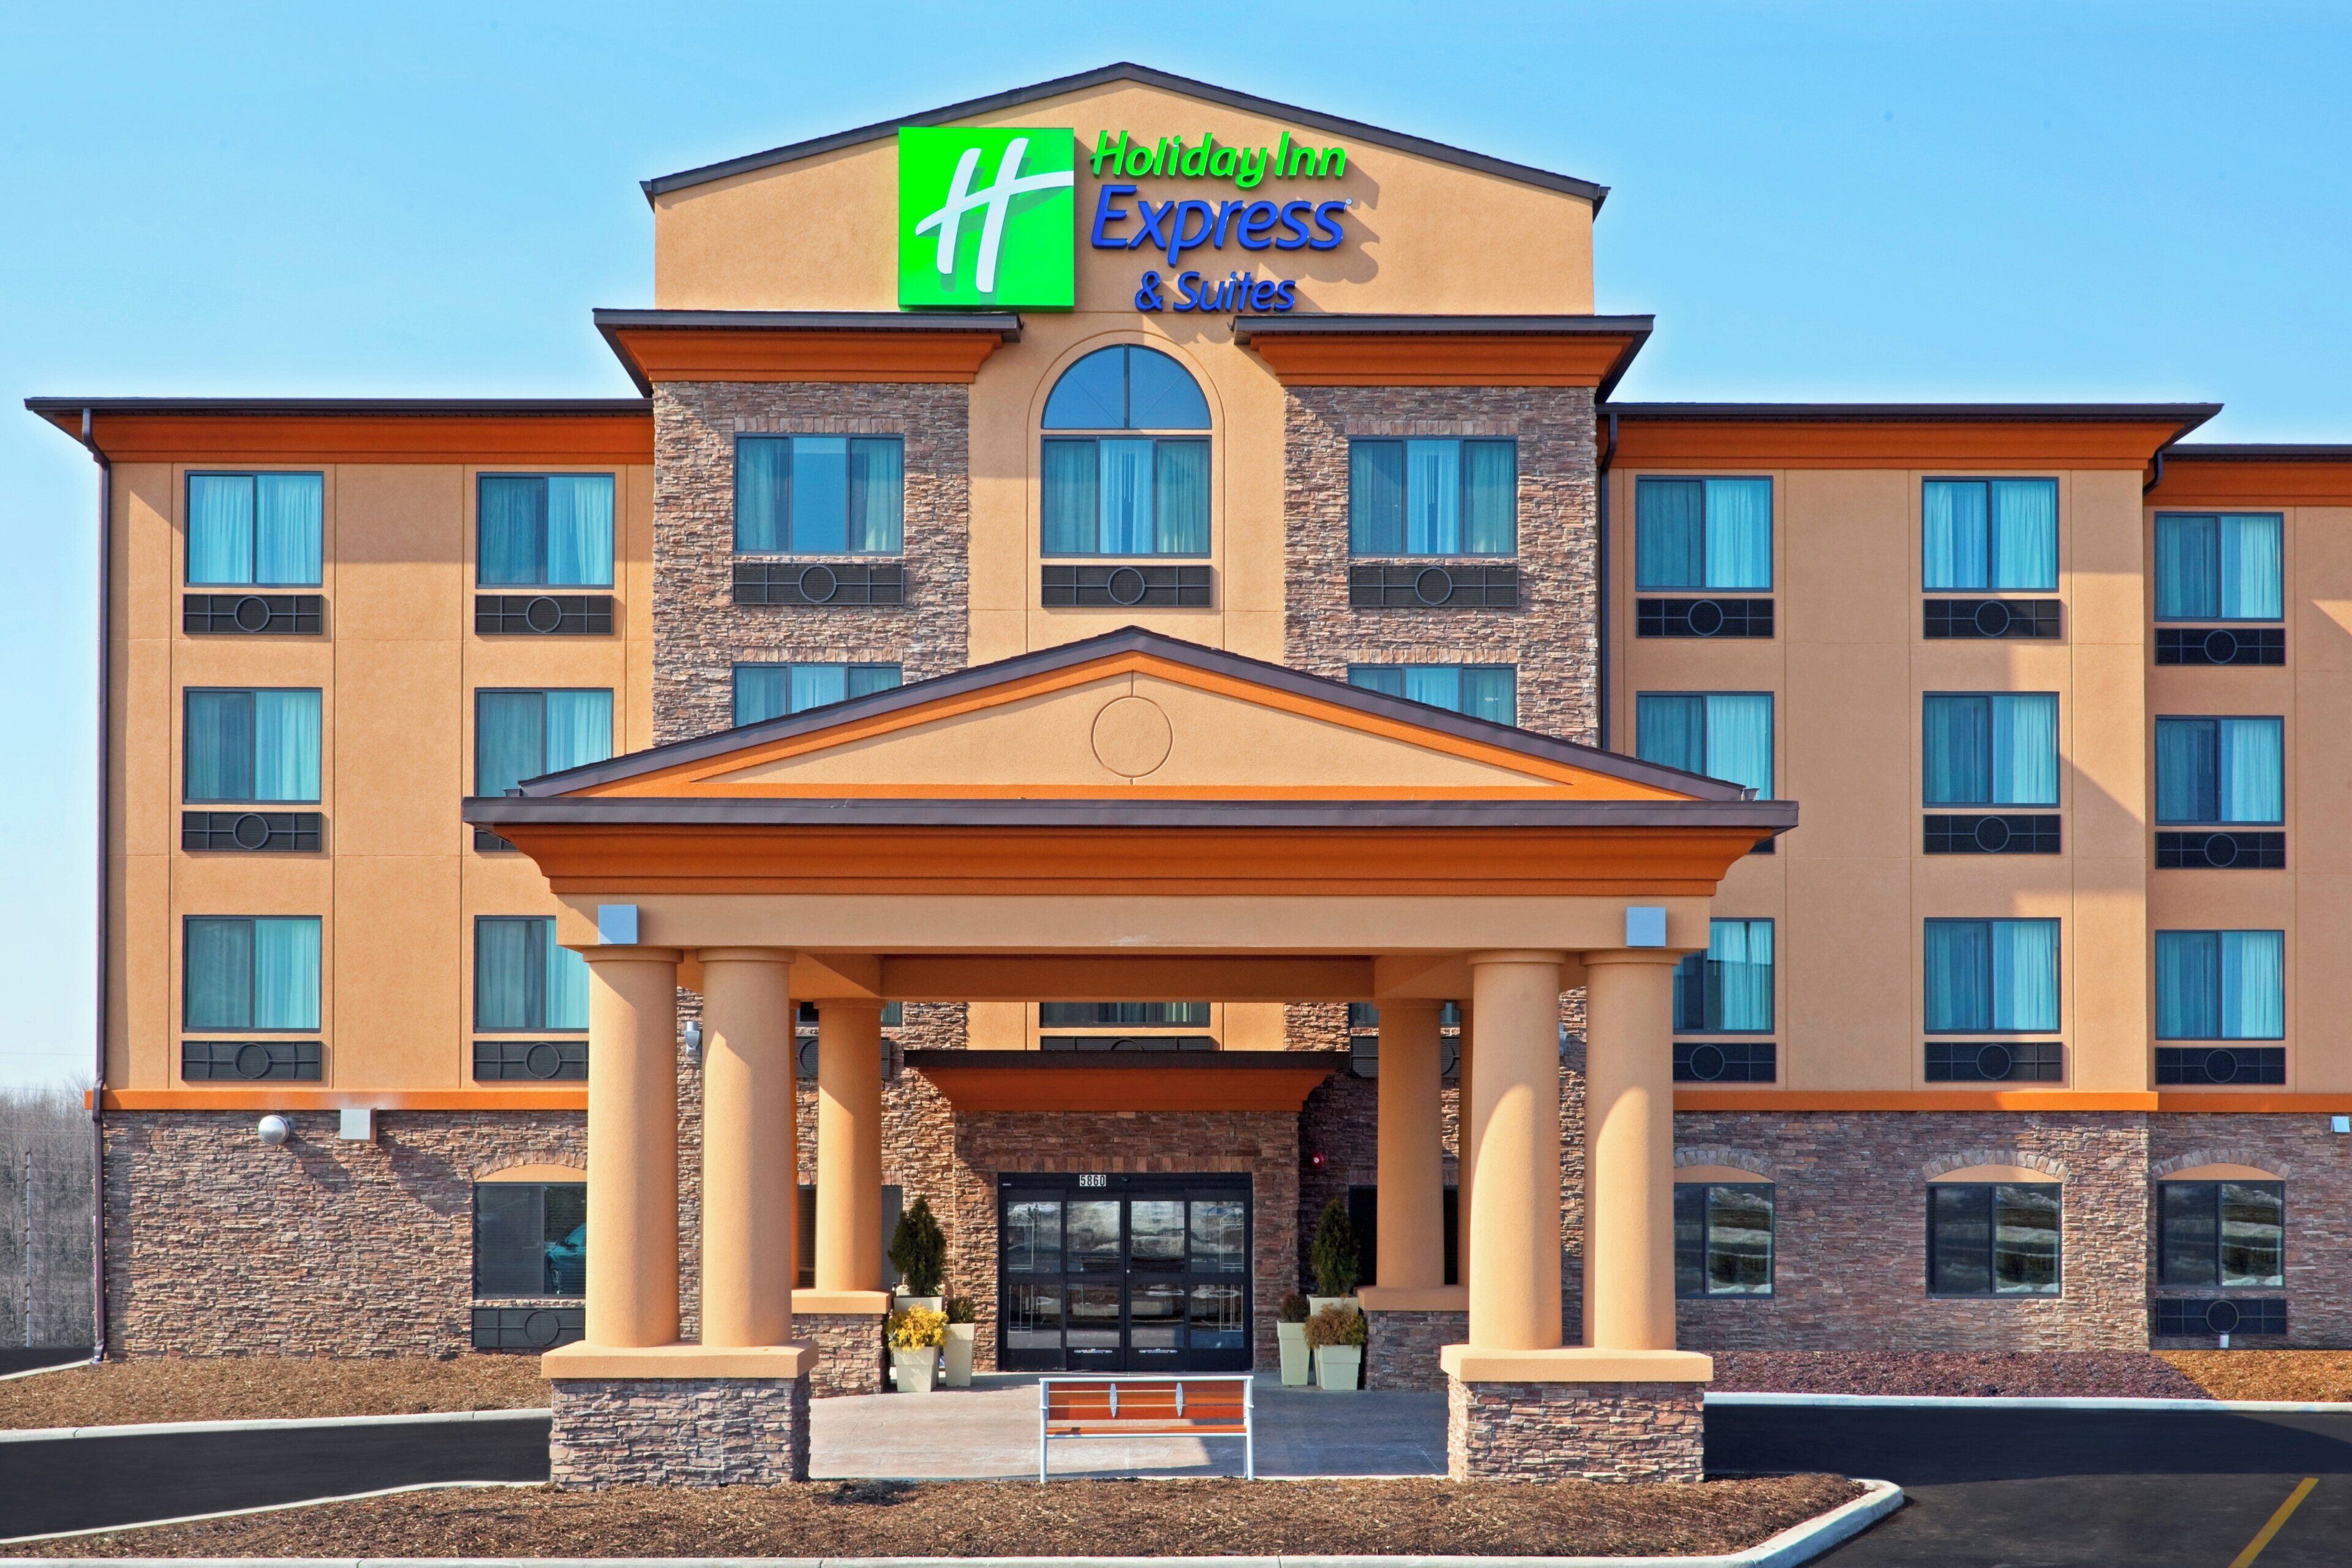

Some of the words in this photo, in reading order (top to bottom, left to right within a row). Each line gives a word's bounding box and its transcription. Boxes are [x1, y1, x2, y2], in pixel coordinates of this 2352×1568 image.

[1089, 130, 1268, 189] Holiday
[1273, 130, 1347, 179] Inn
[1090, 184, 1347, 267] Express
[1134, 271, 1164, 312] &
[1173, 270, 1296, 313] Suites
[1080, 1175, 1106, 1186] 5860
